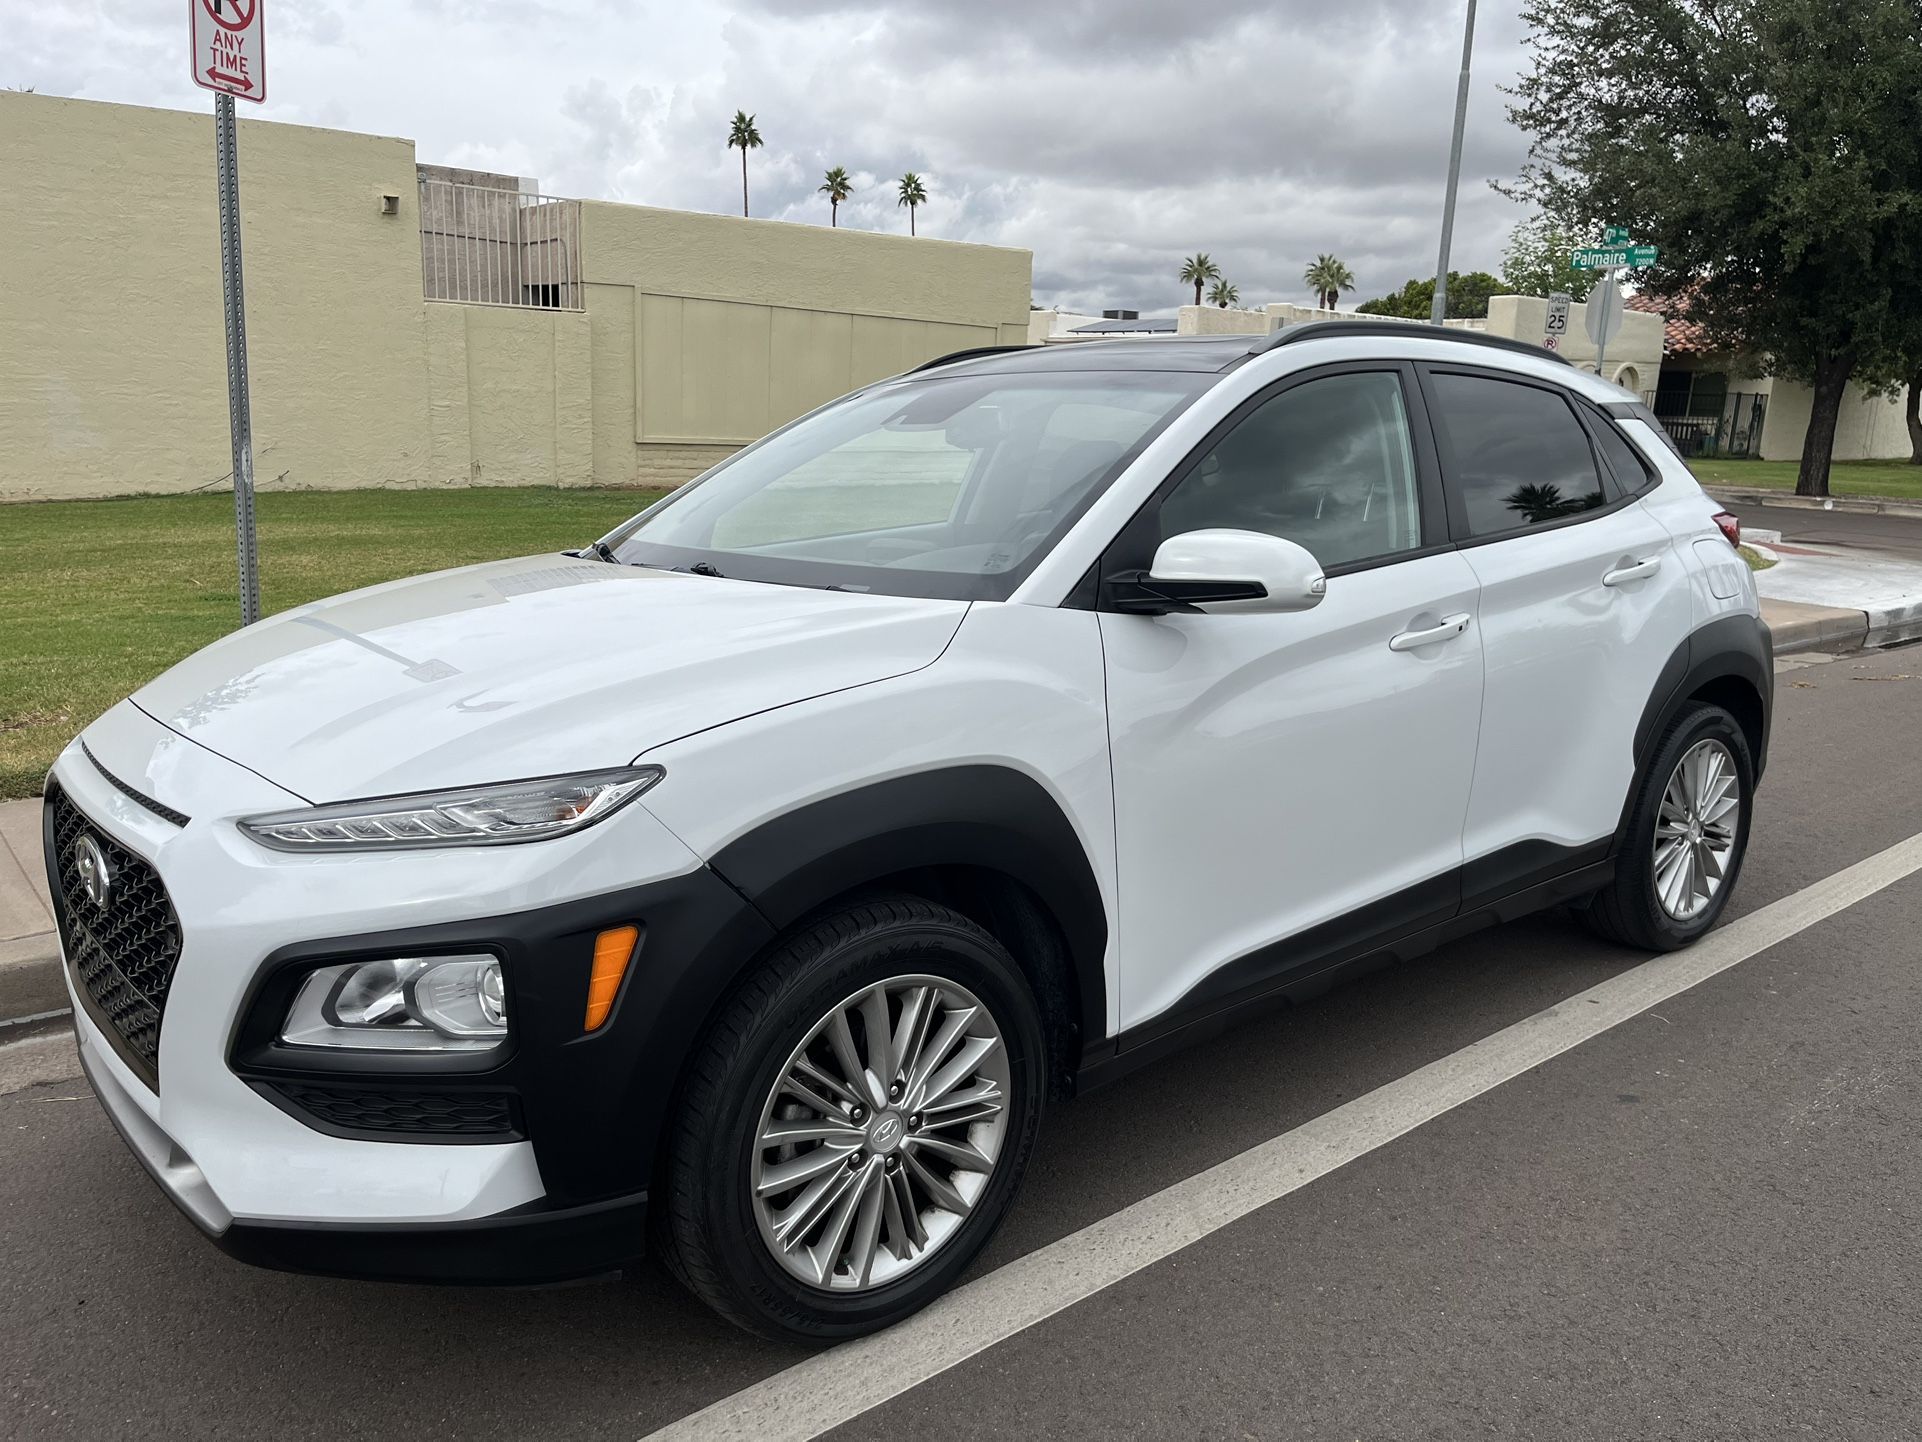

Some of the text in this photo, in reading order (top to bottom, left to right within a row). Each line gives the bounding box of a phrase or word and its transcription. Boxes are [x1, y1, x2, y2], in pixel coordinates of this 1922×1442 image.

[213, 29, 244, 53] ANY
[210, 47, 248, 75] TIME
[1572, 251, 1626, 266] Palmaire
[1550, 296, 1569, 304] SPEED
[1547, 314, 1565, 330] 25
